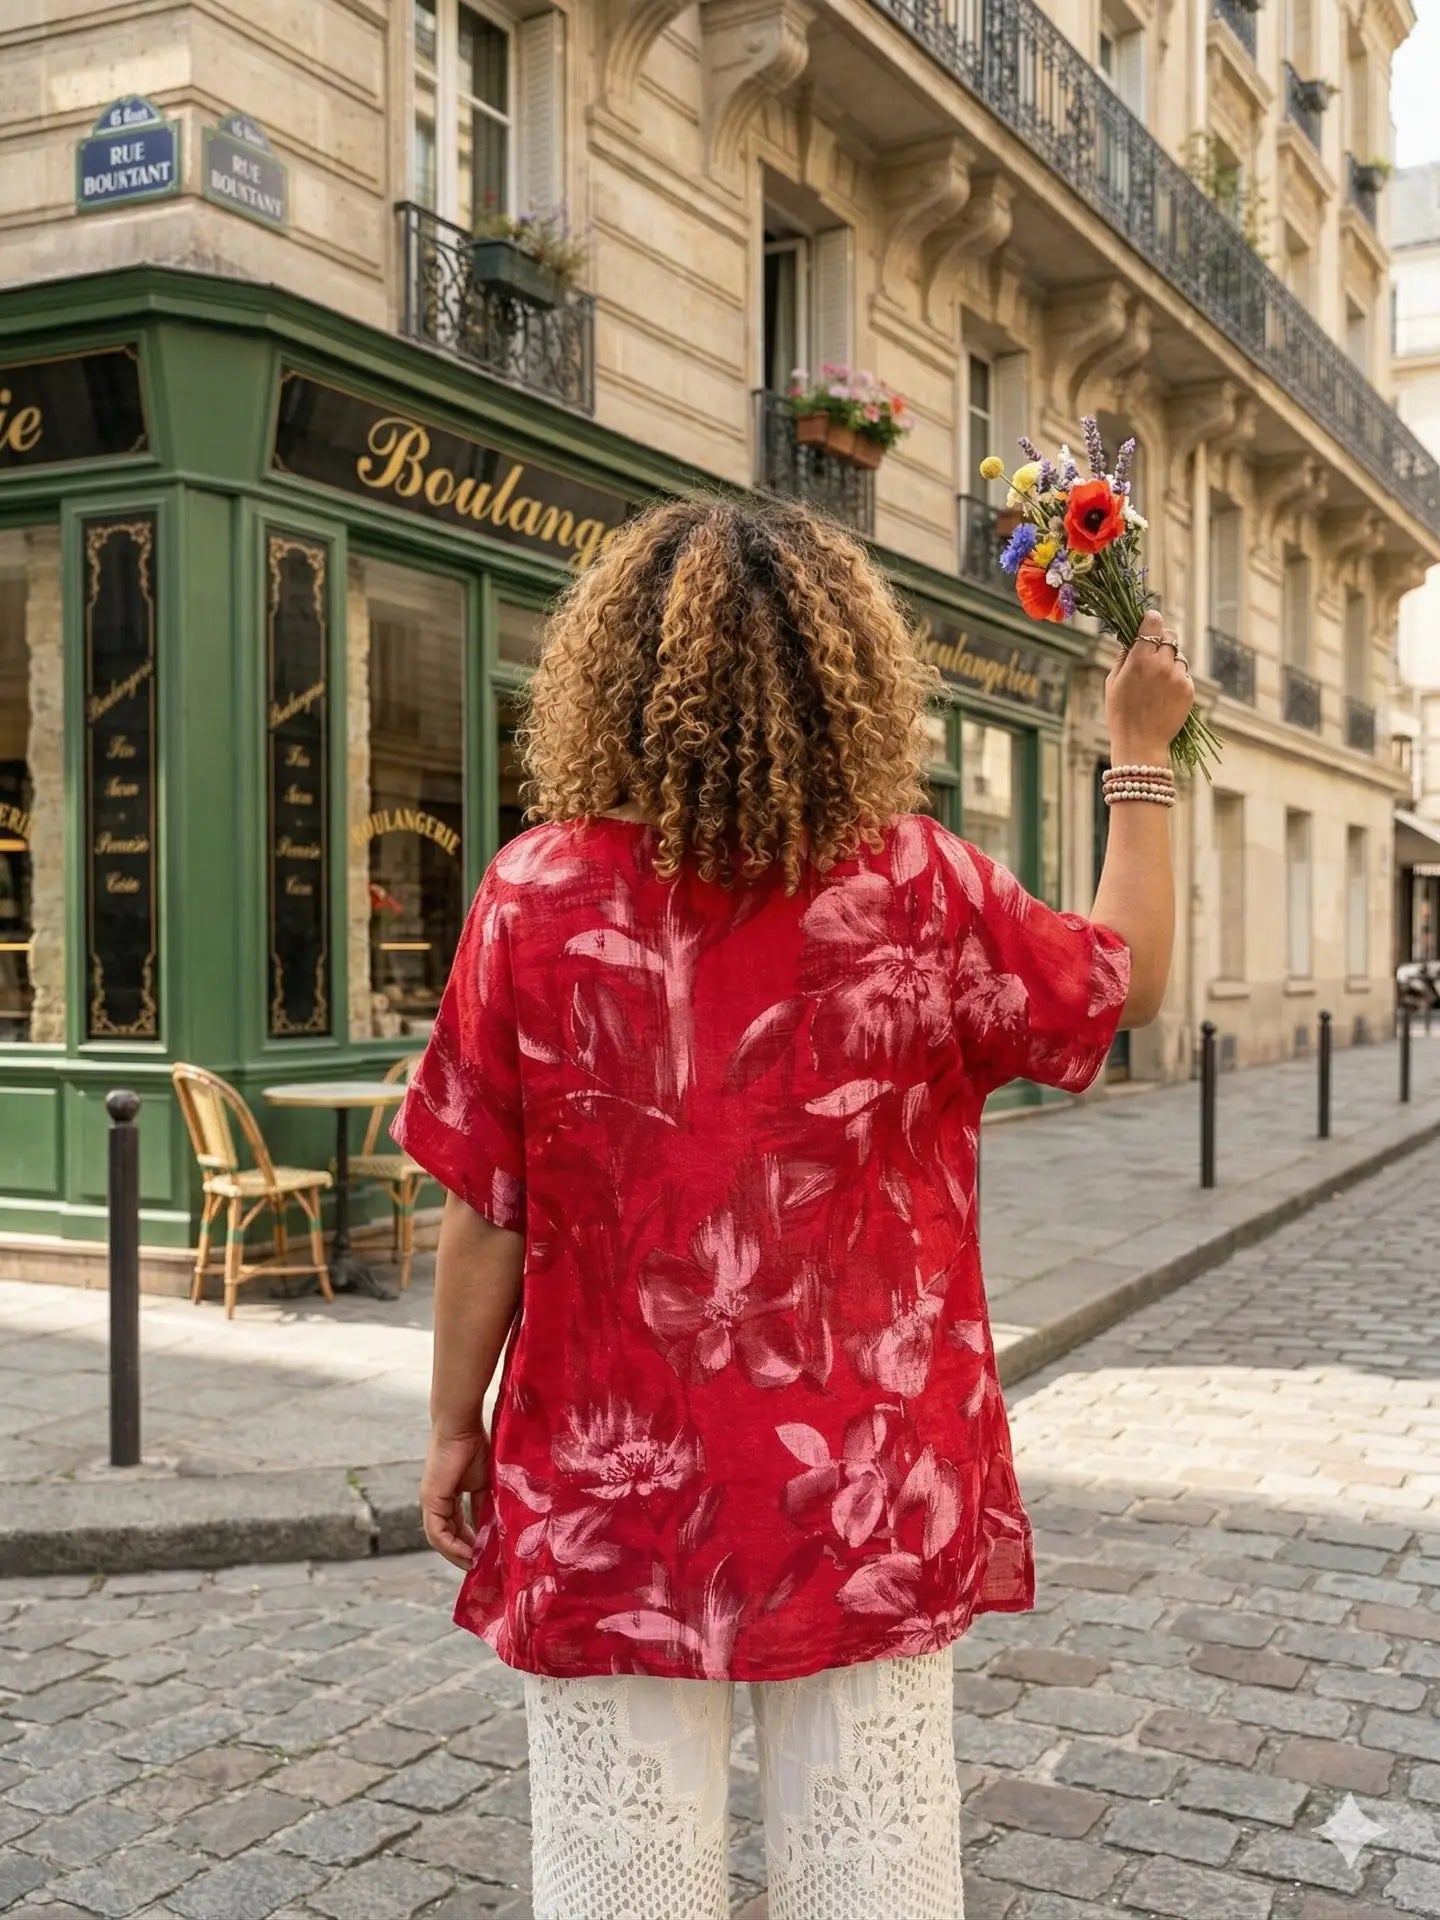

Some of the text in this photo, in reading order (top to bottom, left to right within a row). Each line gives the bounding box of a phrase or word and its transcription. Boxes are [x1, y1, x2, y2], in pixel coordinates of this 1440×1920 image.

[110, 141, 145, 166] RUE
[232, 154, 261, 185] RUE
[351, 809, 460, 856] BOULANGERIE
